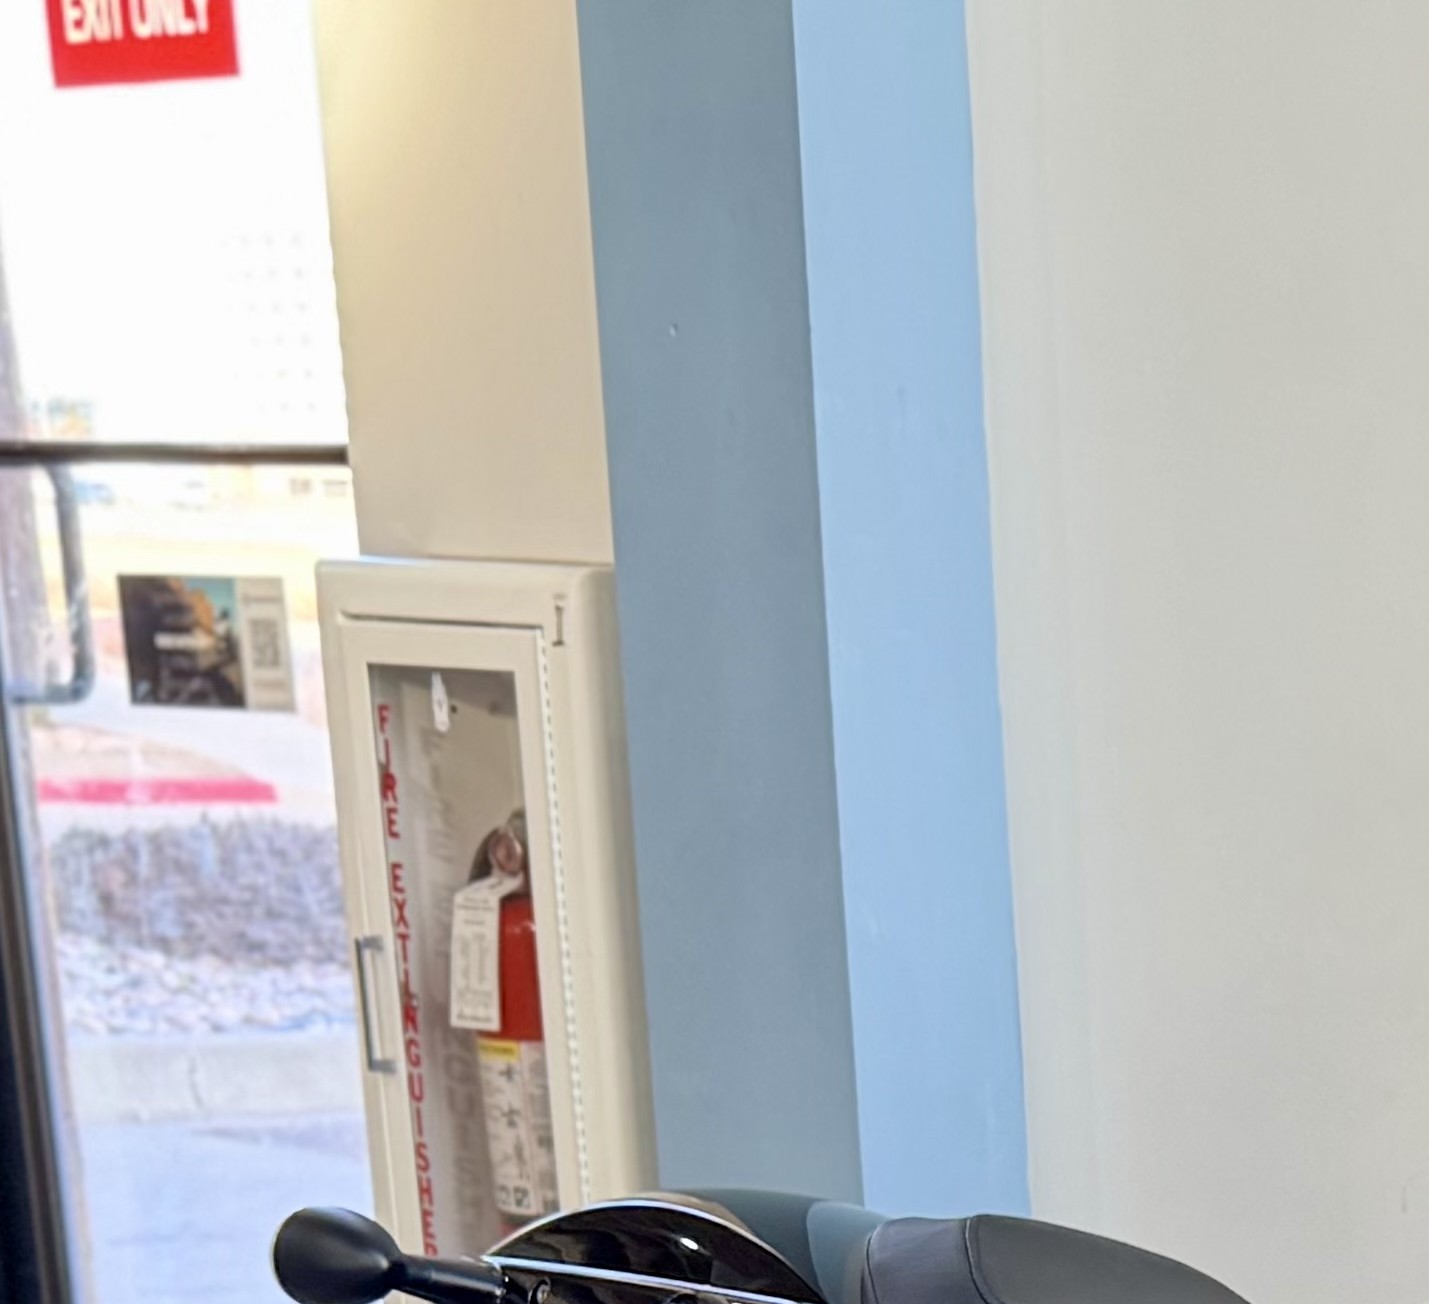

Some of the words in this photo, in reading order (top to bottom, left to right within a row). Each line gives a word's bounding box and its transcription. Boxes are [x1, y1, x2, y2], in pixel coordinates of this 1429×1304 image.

[61, 0, 123, 44] EXIT
[129, 0, 209, 39] ONLY
[376, 703, 400, 839] FIRE
